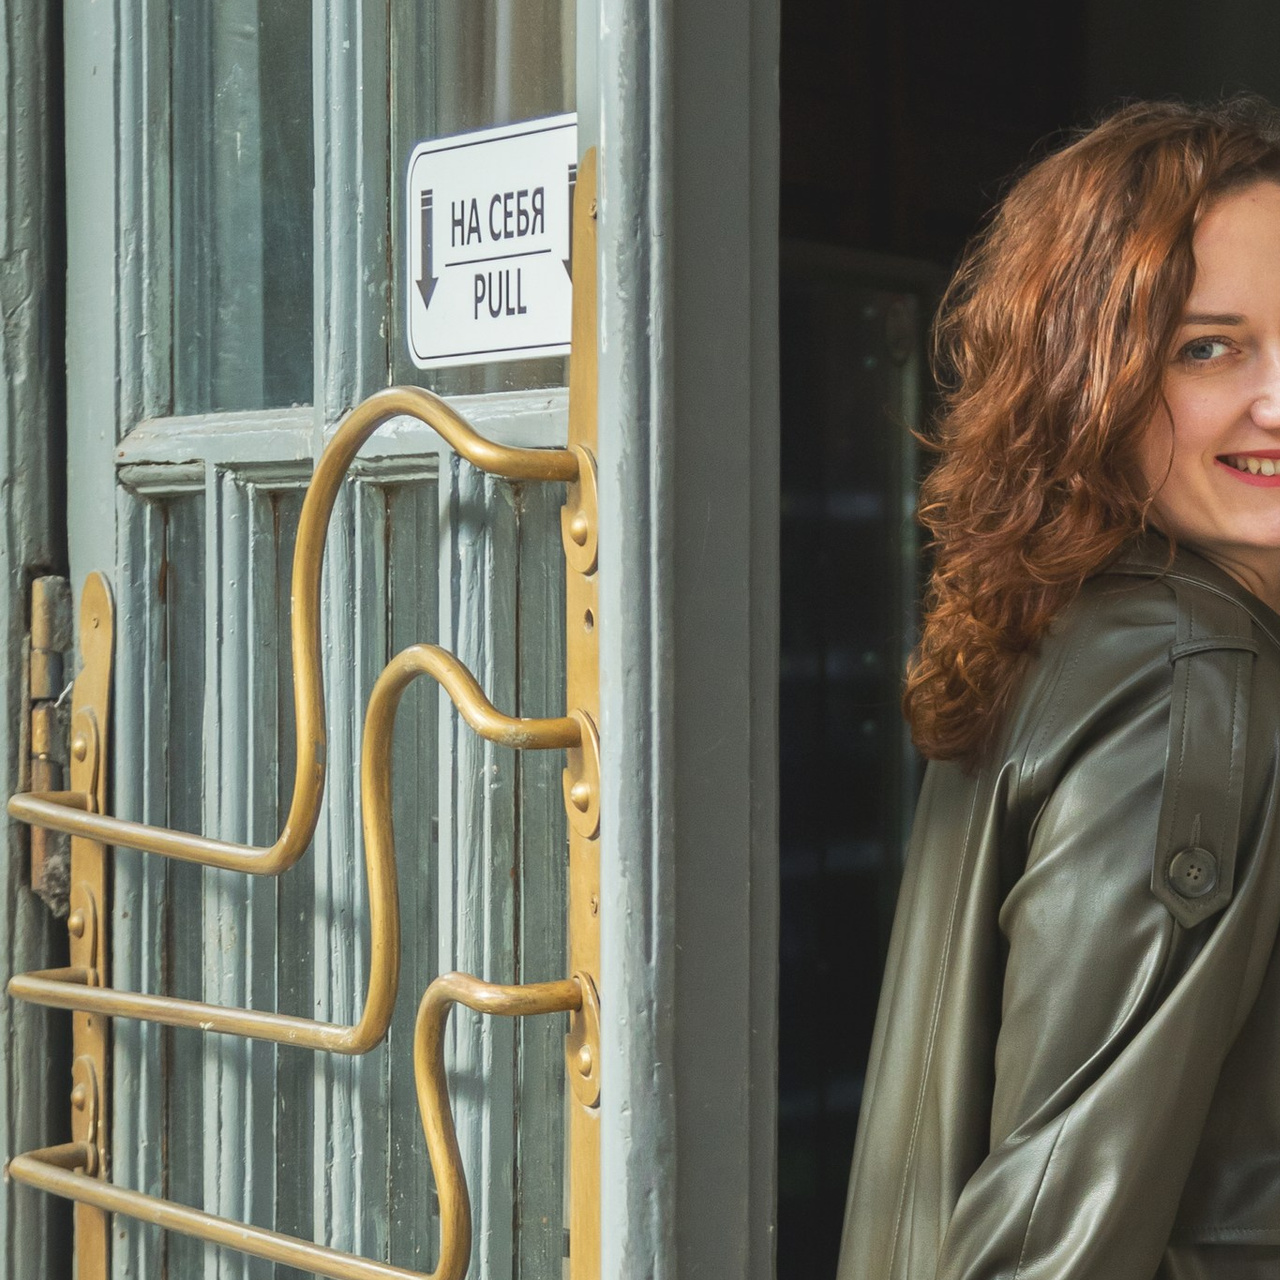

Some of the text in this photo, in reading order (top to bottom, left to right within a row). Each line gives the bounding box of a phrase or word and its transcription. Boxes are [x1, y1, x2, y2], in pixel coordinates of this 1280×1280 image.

[451, 186, 545, 247] НА СЕБЯ
[474, 268, 527, 320] PULL
